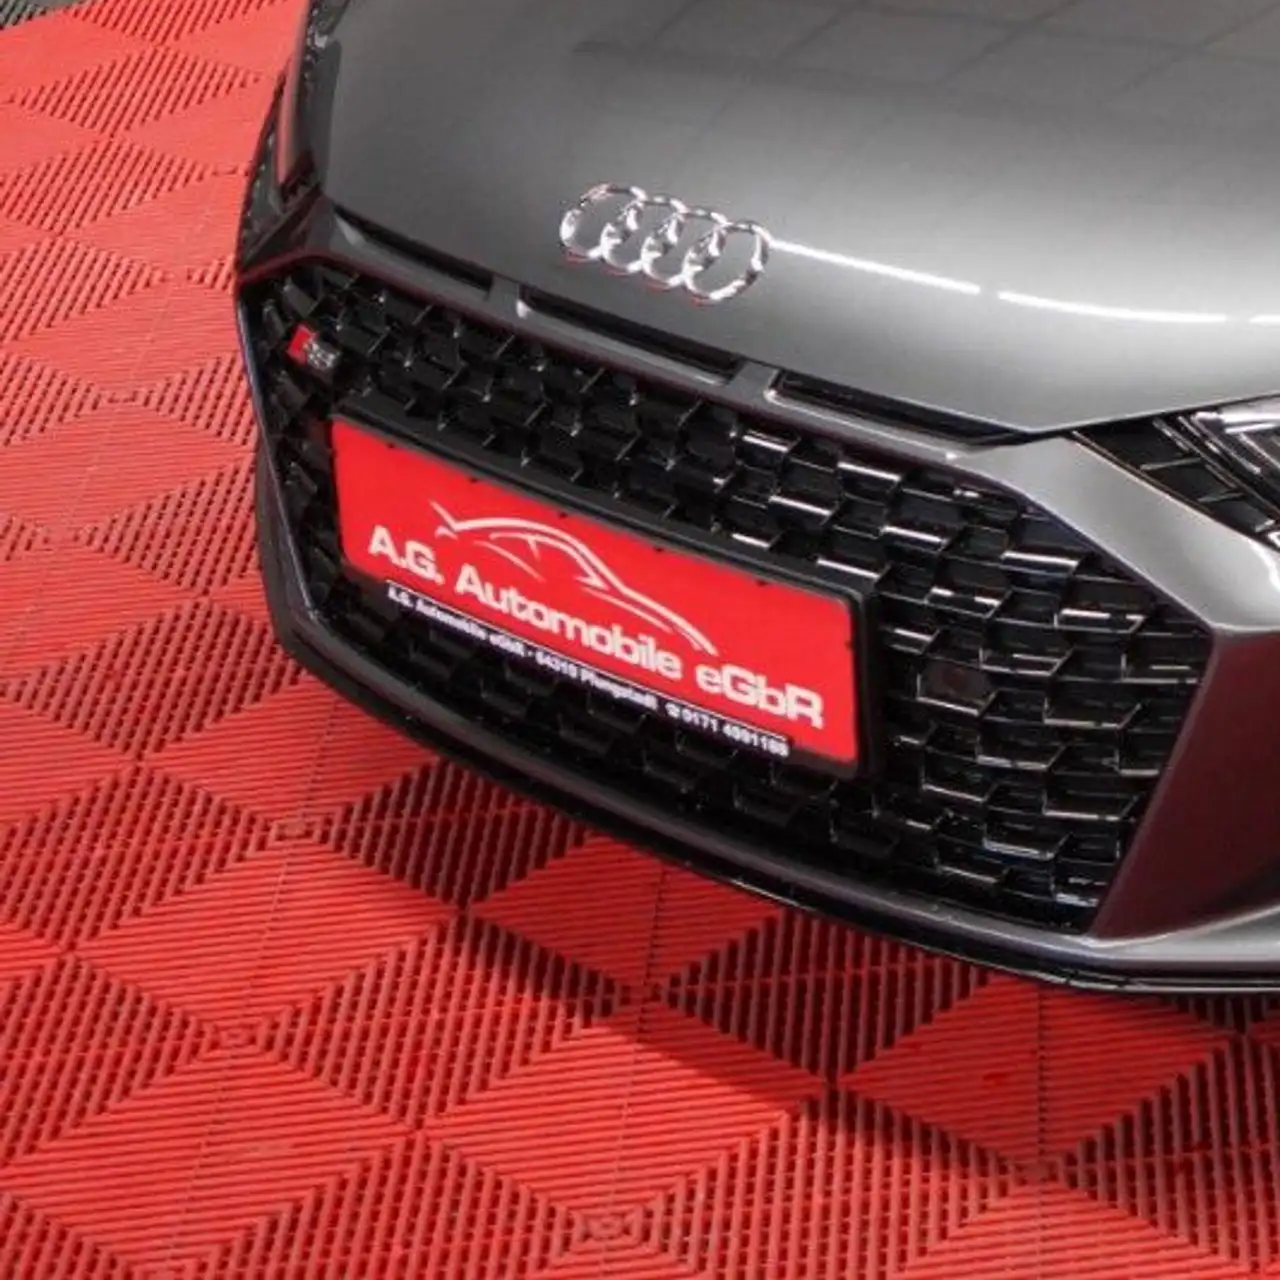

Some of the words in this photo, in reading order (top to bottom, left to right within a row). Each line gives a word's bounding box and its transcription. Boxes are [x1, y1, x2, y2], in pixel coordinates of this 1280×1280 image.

[369, 525, 445, 586] A.G.
[455, 563, 683, 681] Automobile
[695, 663, 823, 729] eGbR
